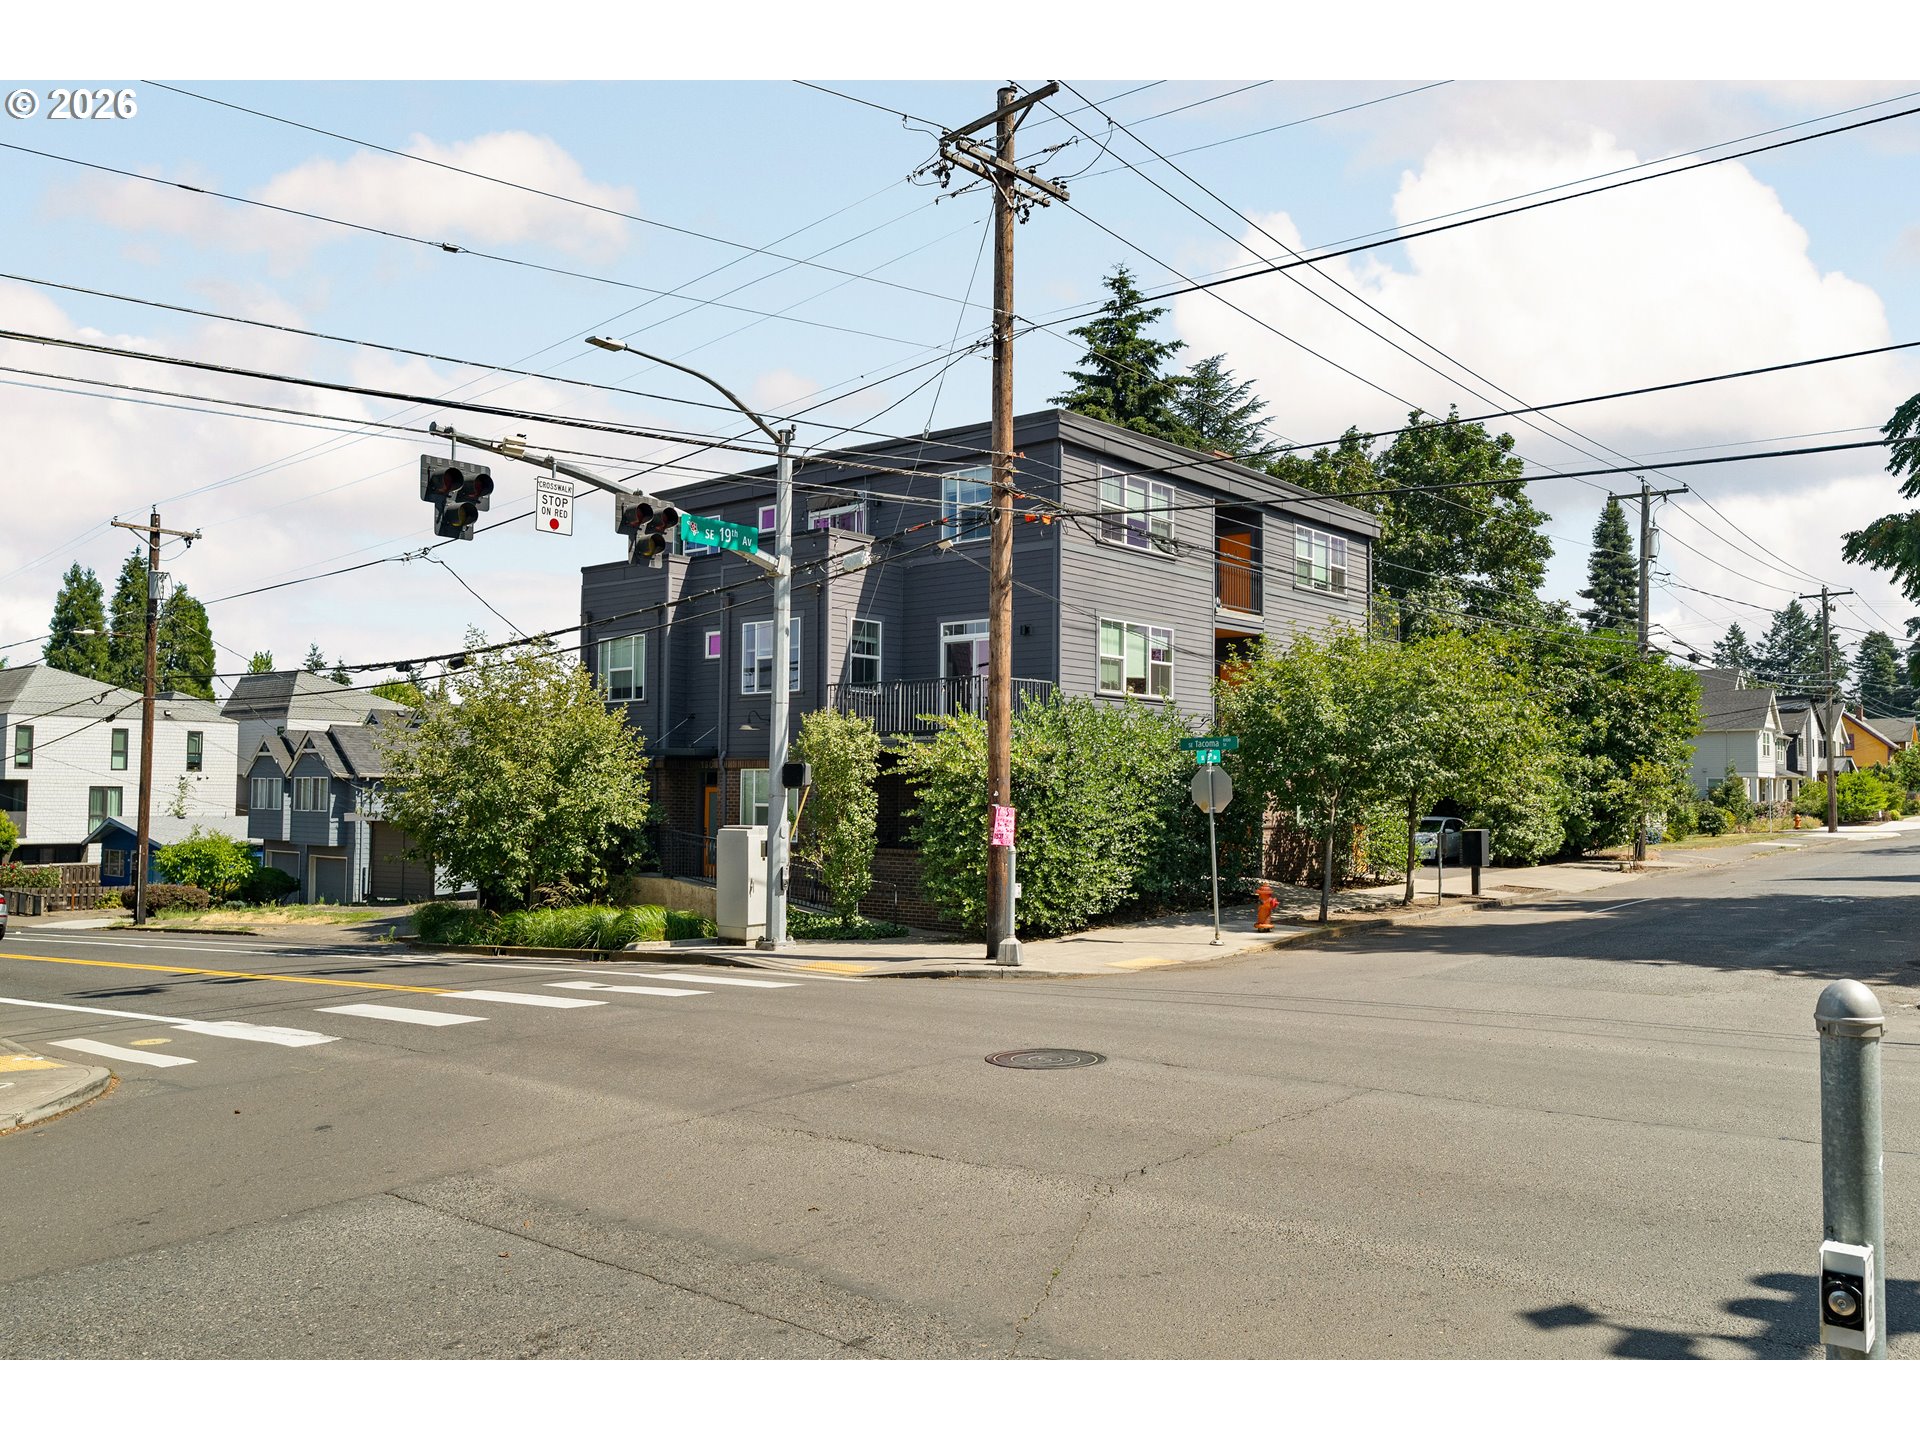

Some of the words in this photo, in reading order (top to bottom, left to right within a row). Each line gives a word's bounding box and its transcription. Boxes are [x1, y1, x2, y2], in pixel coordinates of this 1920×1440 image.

[539, 481, 572, 493] CROSSWALK
[541, 494, 569, 508] STOP
[541, 506, 551, 516] ON
[554, 508, 568, 519] RED
[705, 529, 715, 540] SE
[719, 527, 739, 543] 19th
[742, 536, 752, 547] Av
[1195, 740, 1219, 748] Tacoma
